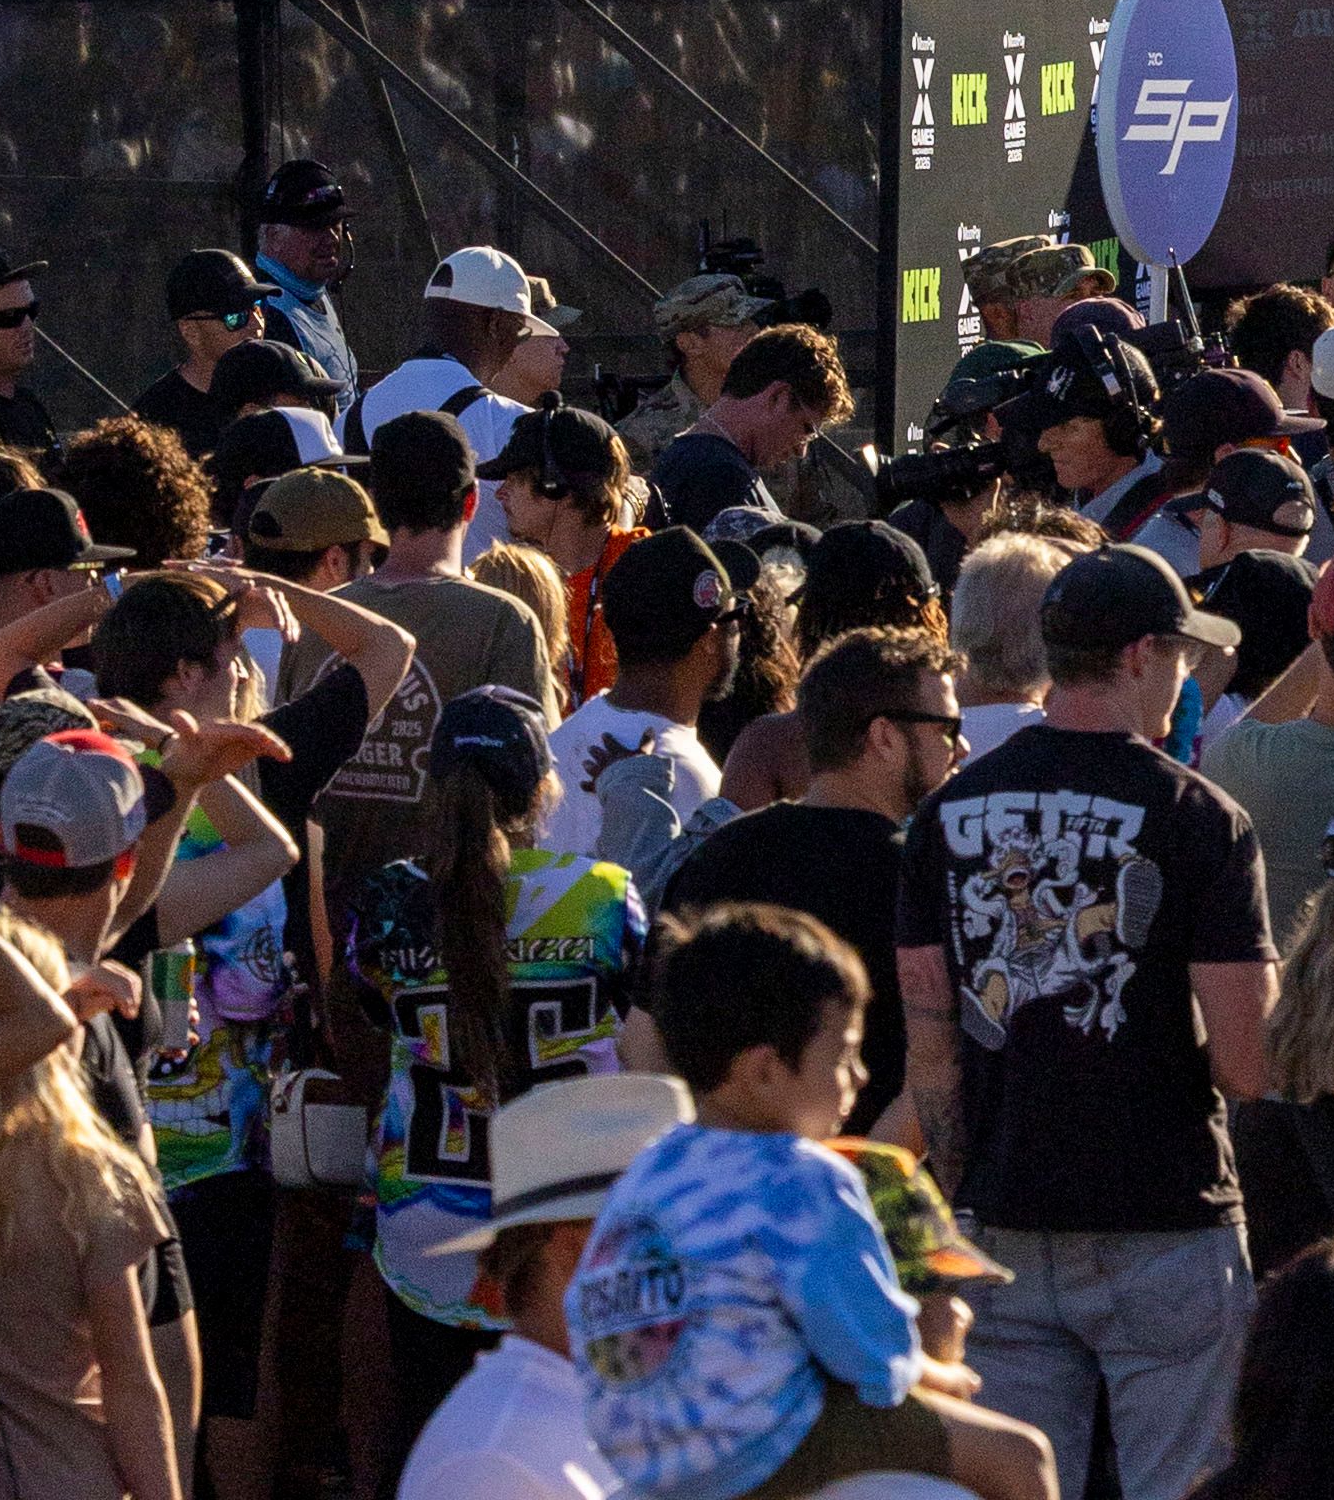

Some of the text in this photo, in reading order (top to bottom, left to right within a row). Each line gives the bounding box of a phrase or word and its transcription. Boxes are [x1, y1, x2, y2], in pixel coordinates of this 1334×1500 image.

[951, 73, 988, 126] KICK
[1041, 60, 1075, 117] KICK
[911, 128, 935, 147] GAMES
[1004, 121, 1027, 141] GAMES
[902, 266, 941, 324] KICK
